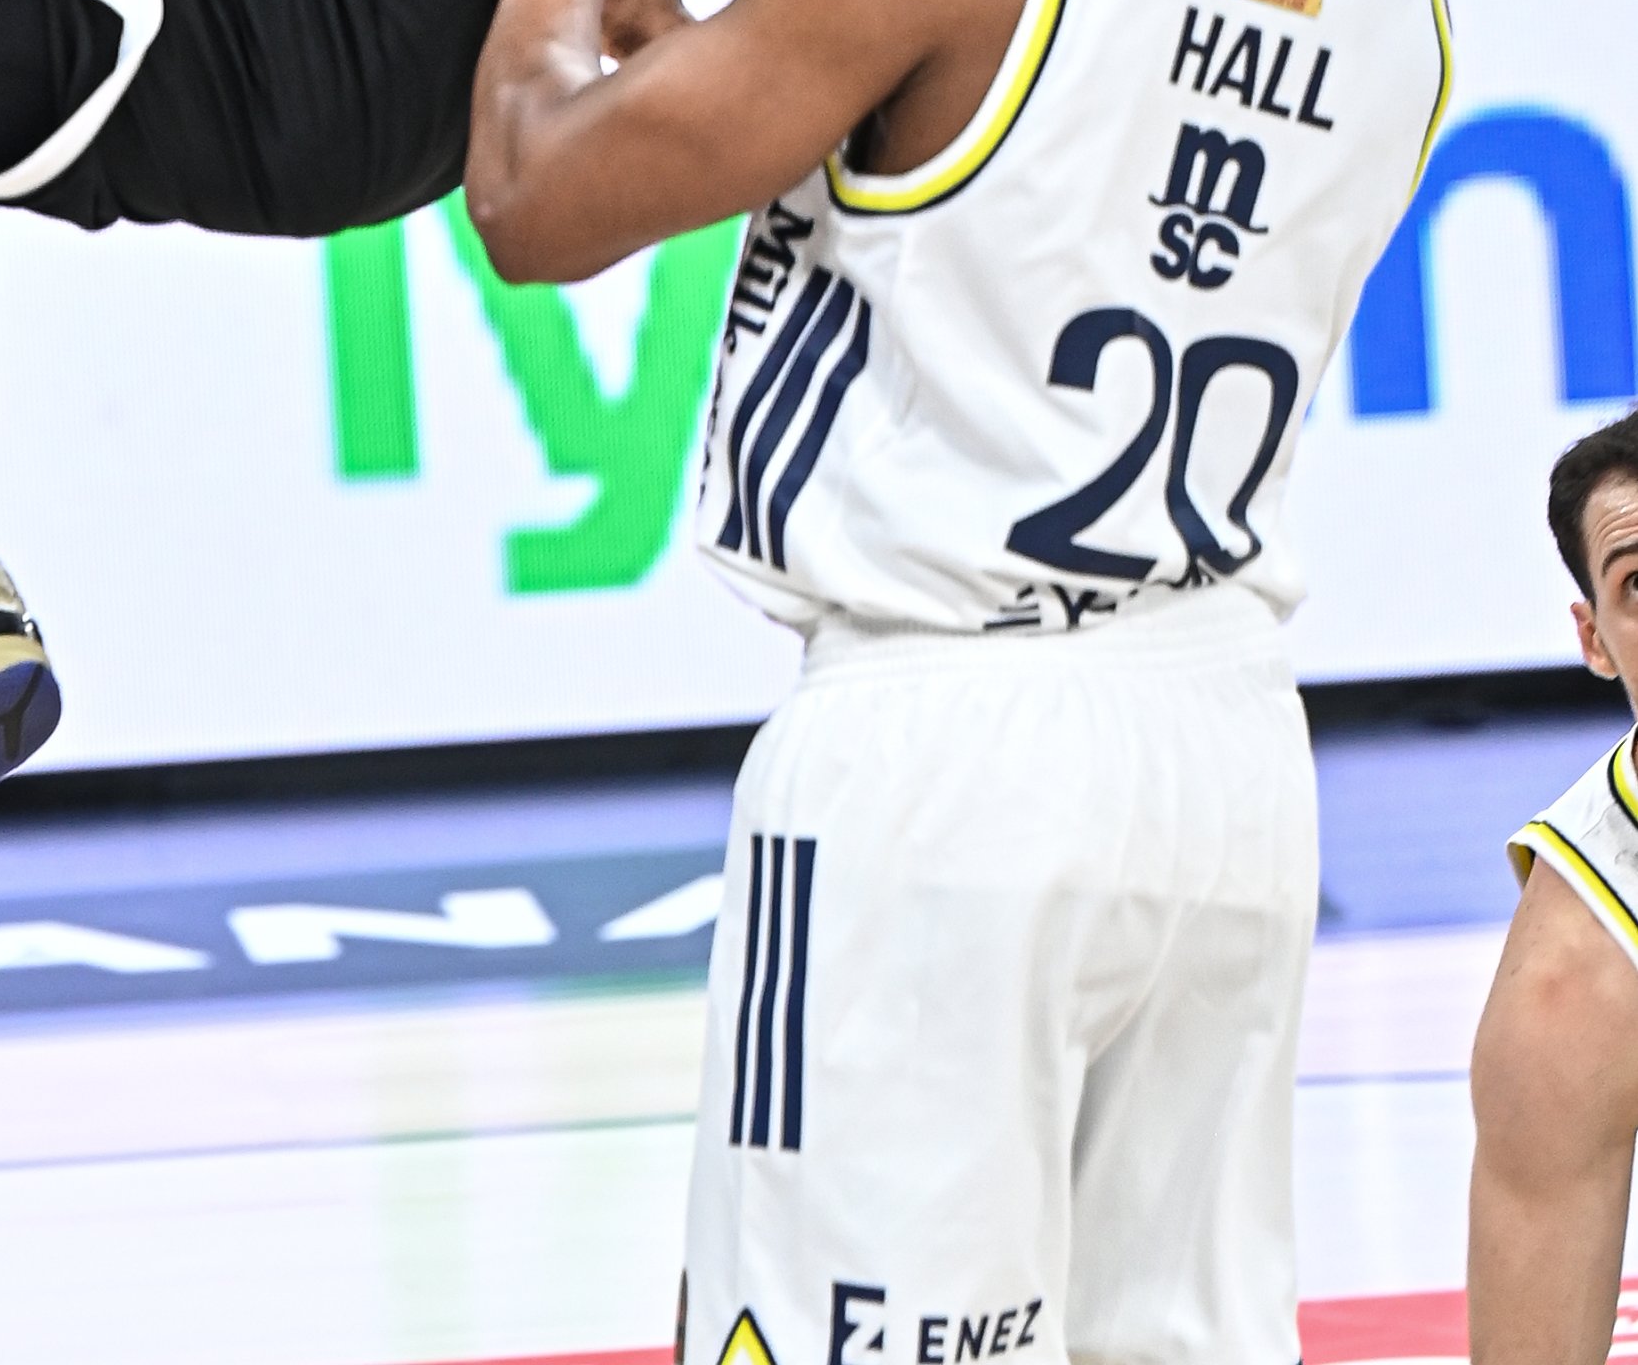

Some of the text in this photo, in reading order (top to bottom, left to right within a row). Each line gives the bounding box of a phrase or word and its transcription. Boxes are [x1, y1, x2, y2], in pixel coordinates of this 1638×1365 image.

[1169, 3, 1335, 132] HALL
[1007, 307, 1300, 579] 20
[918, 1298, 1043, 1365] ENEZ
